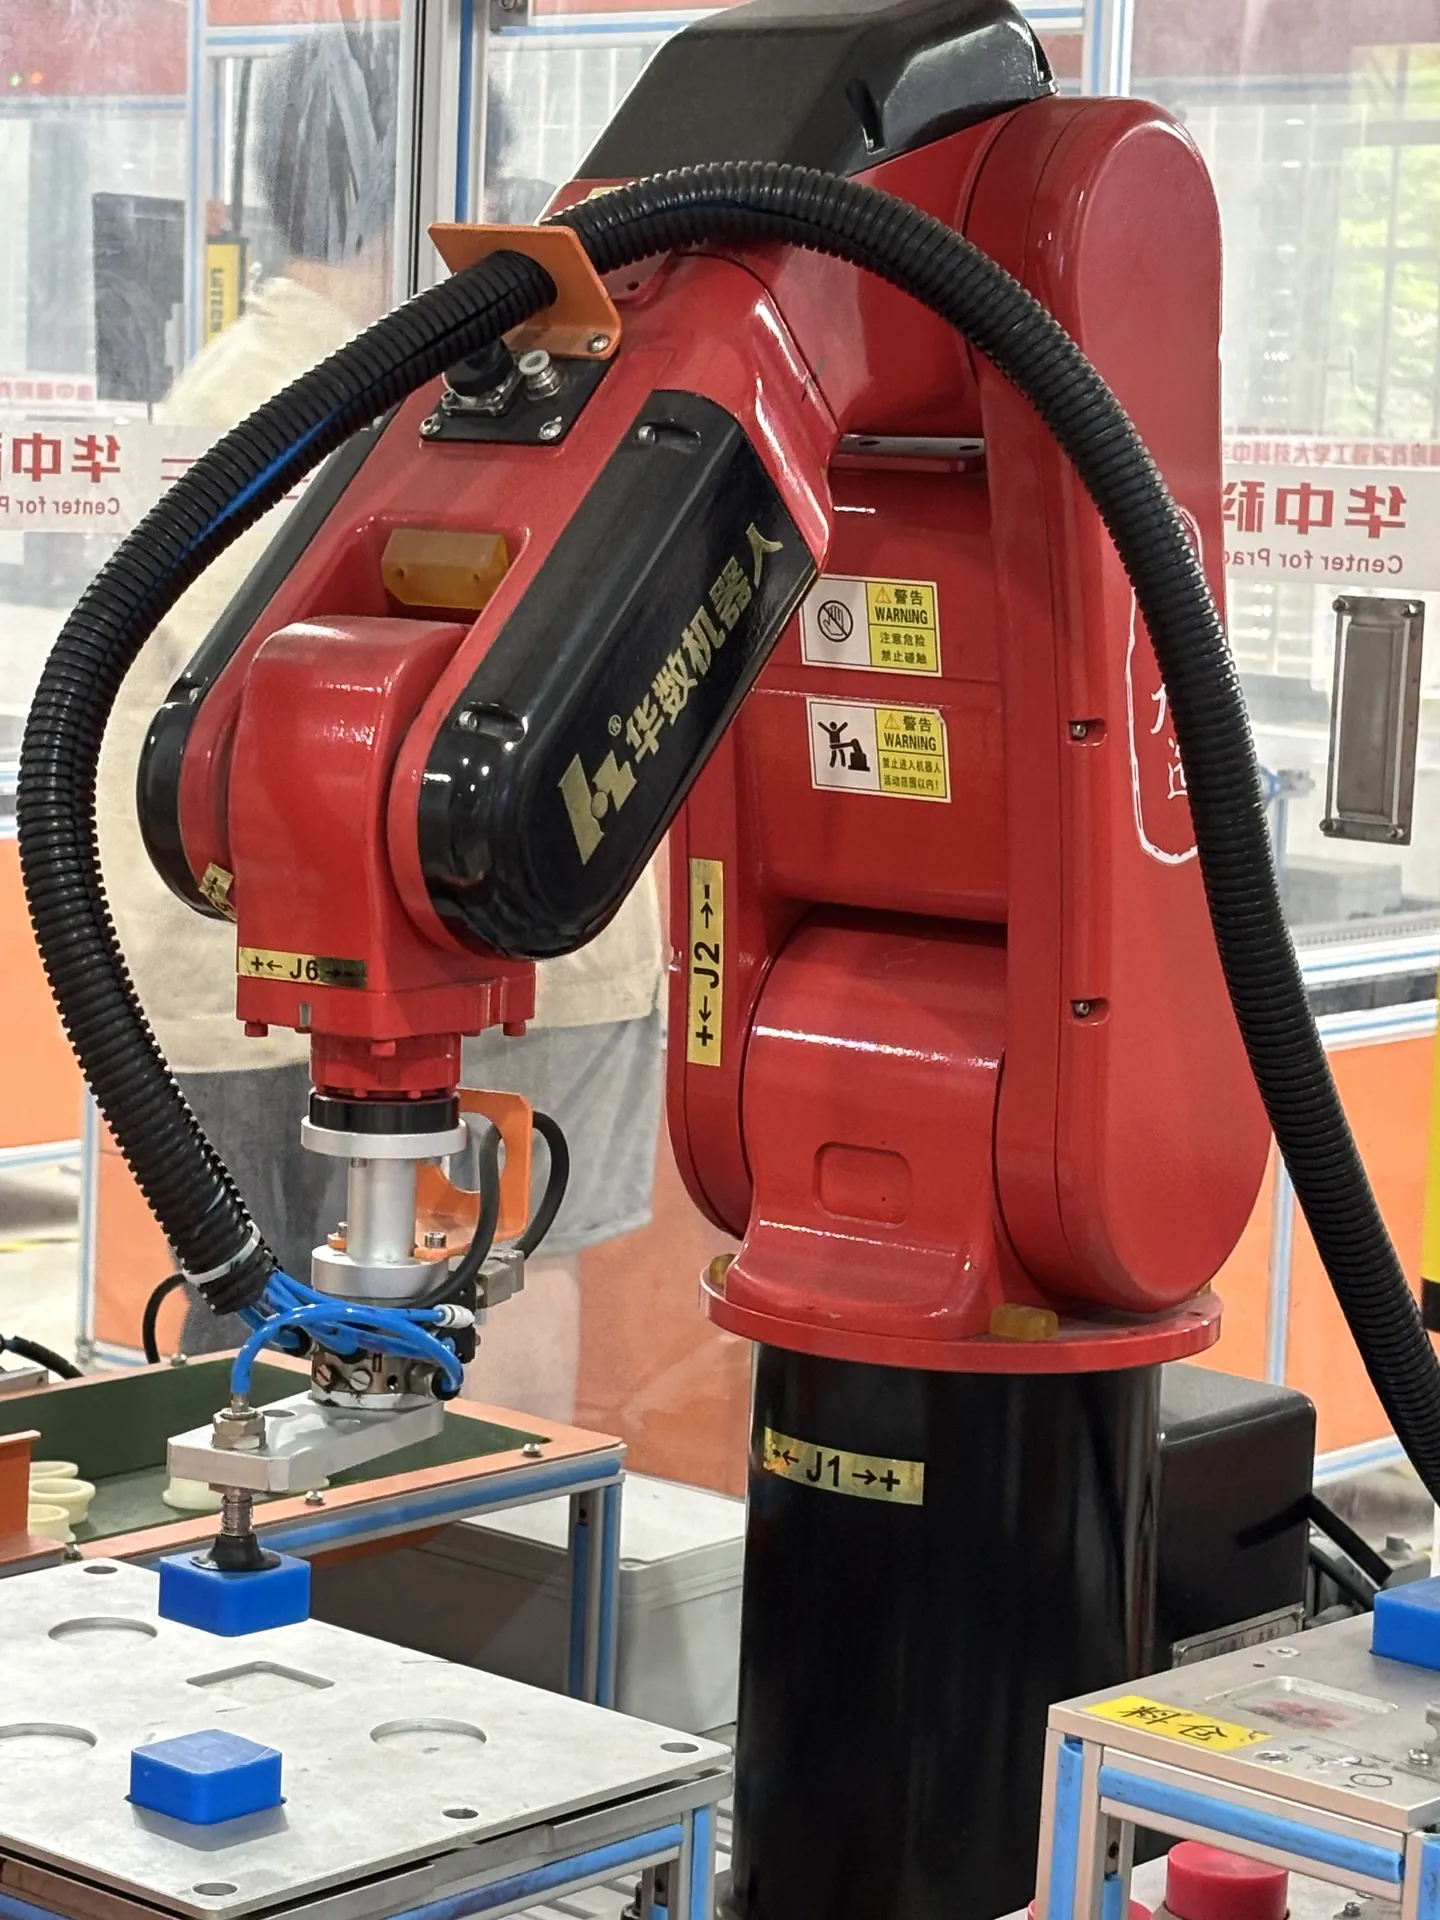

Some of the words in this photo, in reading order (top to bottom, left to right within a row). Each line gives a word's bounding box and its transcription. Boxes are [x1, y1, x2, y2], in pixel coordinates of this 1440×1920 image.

[894, 588, 924, 606] 警告
[874, 606, 928, 625] WARNING
[626, 522, 784, 764] 华数机器人
[880, 631, 926, 648] 注意危险
[903, 714, 932, 732] 警告
[884, 732, 937, 751] WARNING
[289, 957, 319, 981] J6
[693, 941, 720, 990] J2
[805, 1451, 841, 1487] J1
